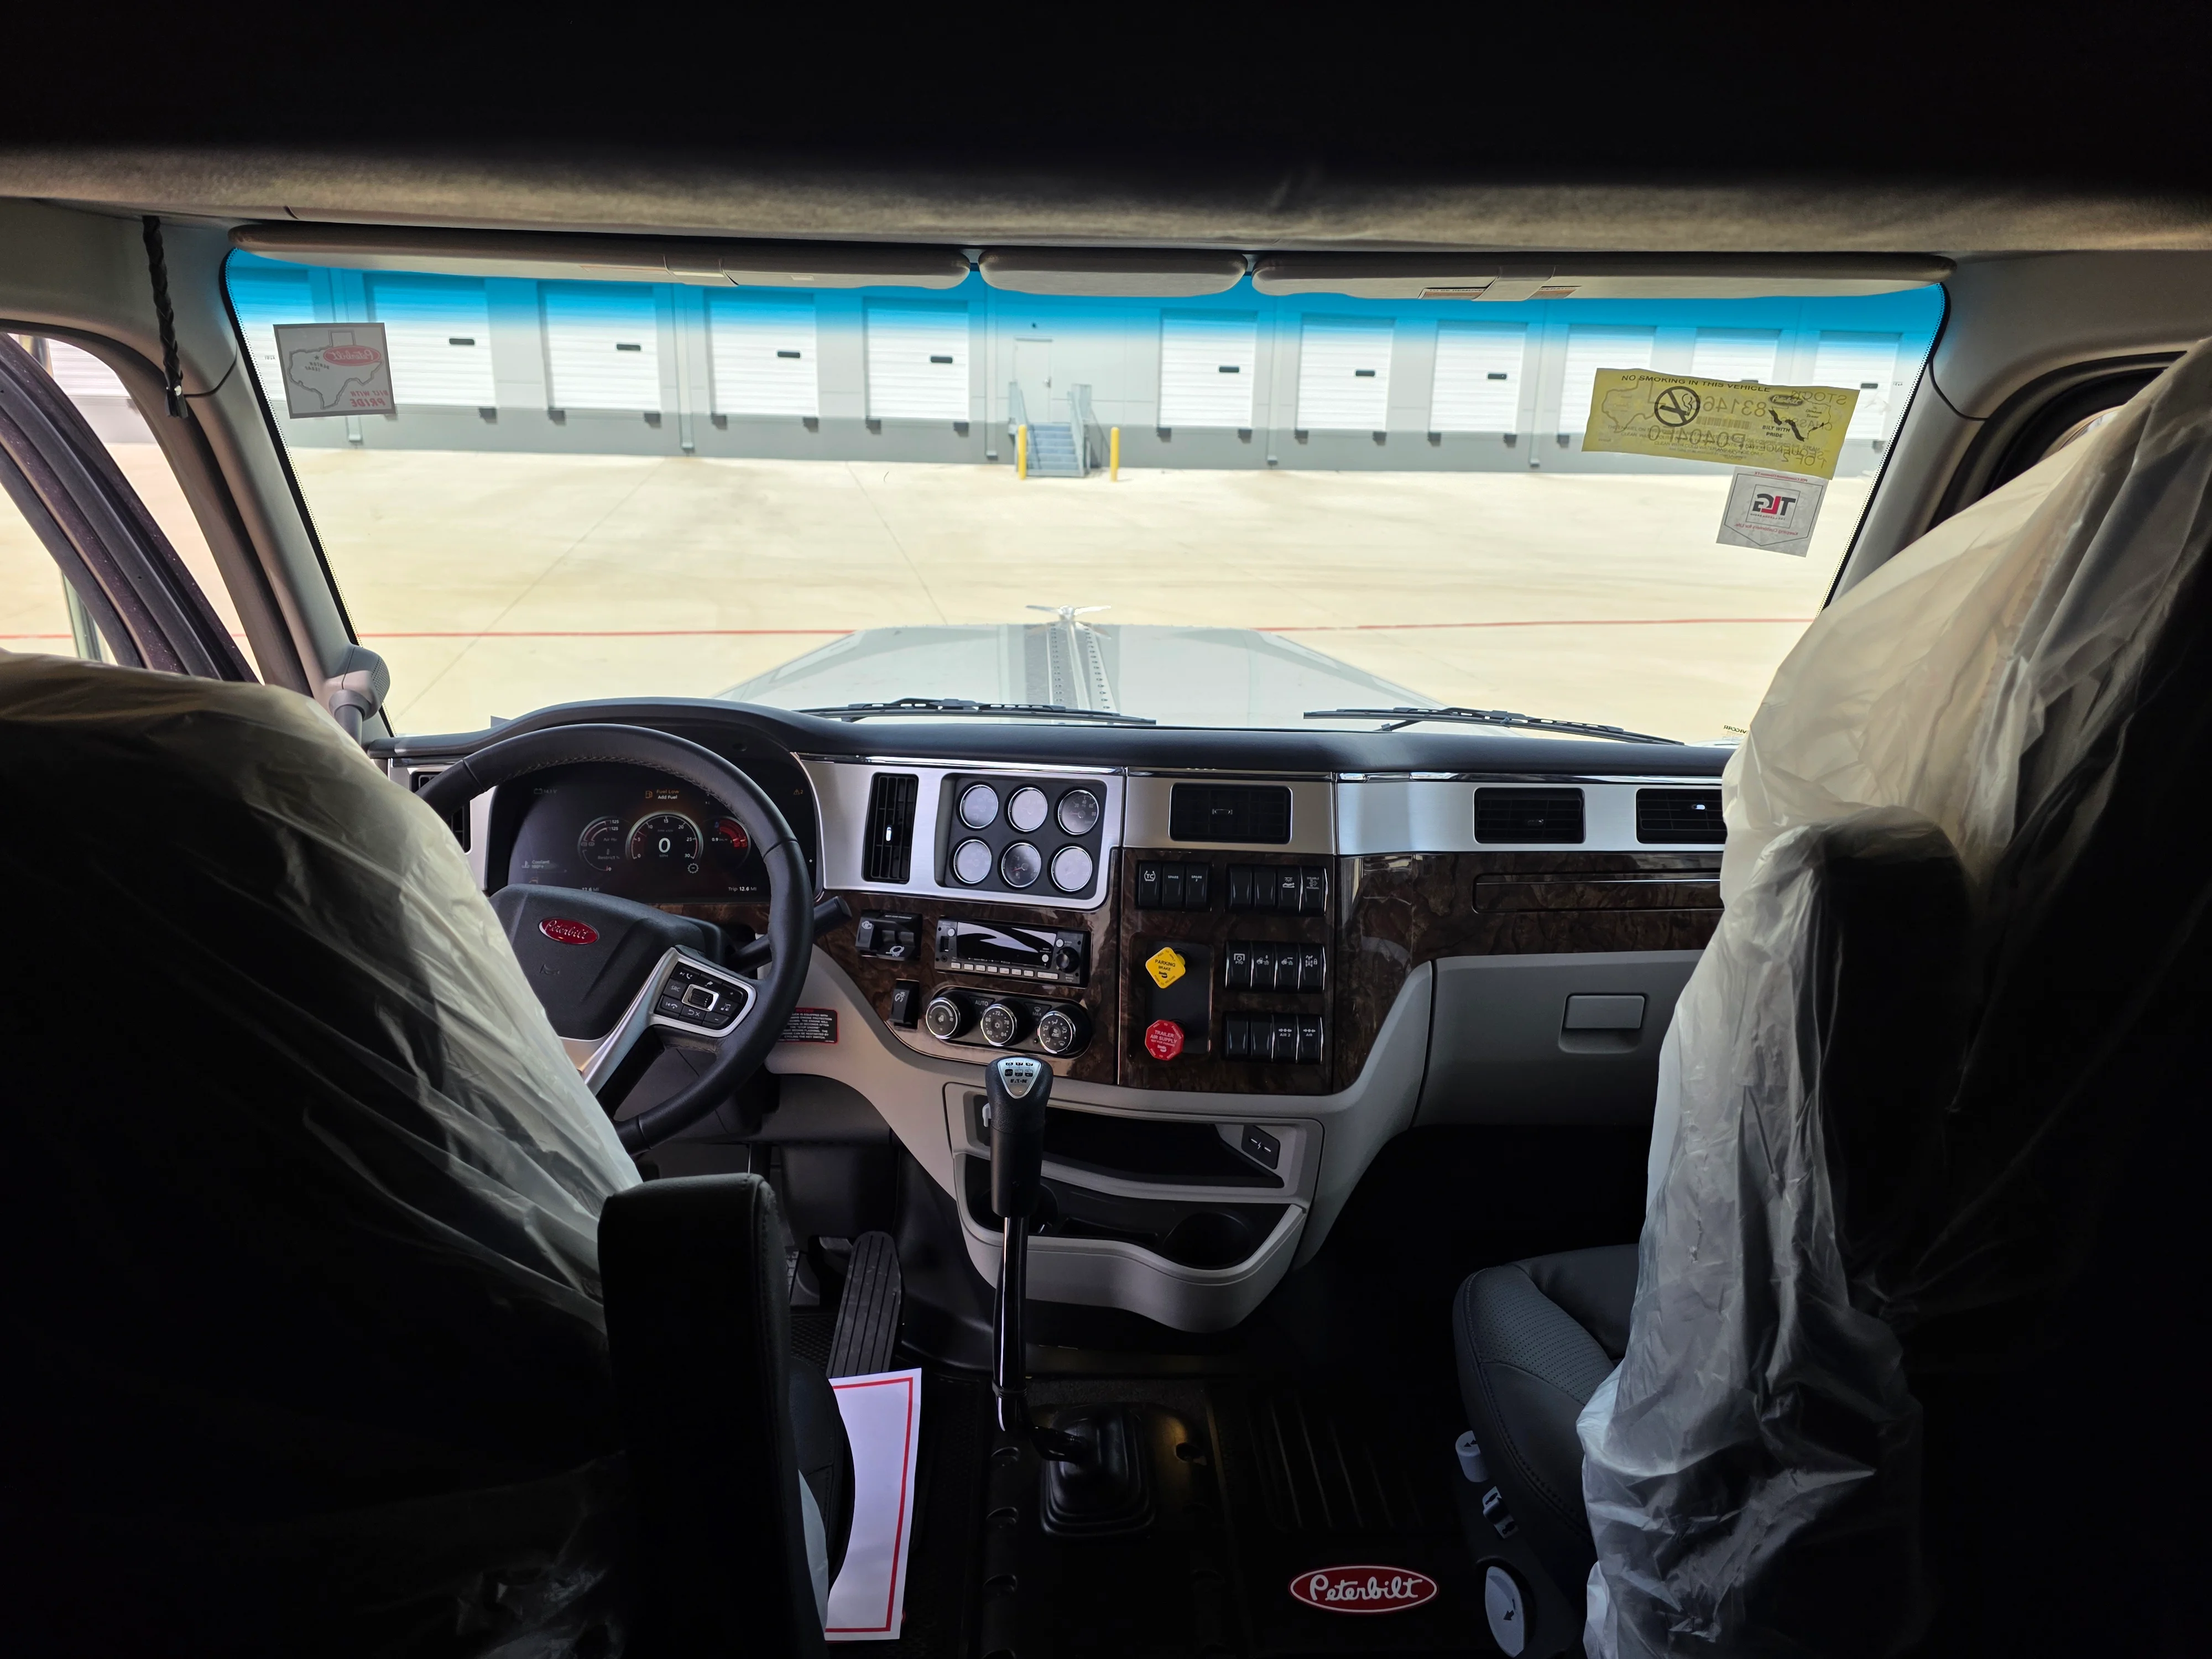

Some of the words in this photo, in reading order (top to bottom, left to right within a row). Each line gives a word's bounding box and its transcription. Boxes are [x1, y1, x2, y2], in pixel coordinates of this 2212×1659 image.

[1639, 375, 1686, 384] SMOKING
[1727, 383, 1771, 392] VEHICLE
[658, 837, 671, 853] 0
[1155, 959, 1176, 967] PARKING
[1155, 1030, 1174, 1038] TRAILER
[1310, 1574, 1423, 1601] Peterbilt
